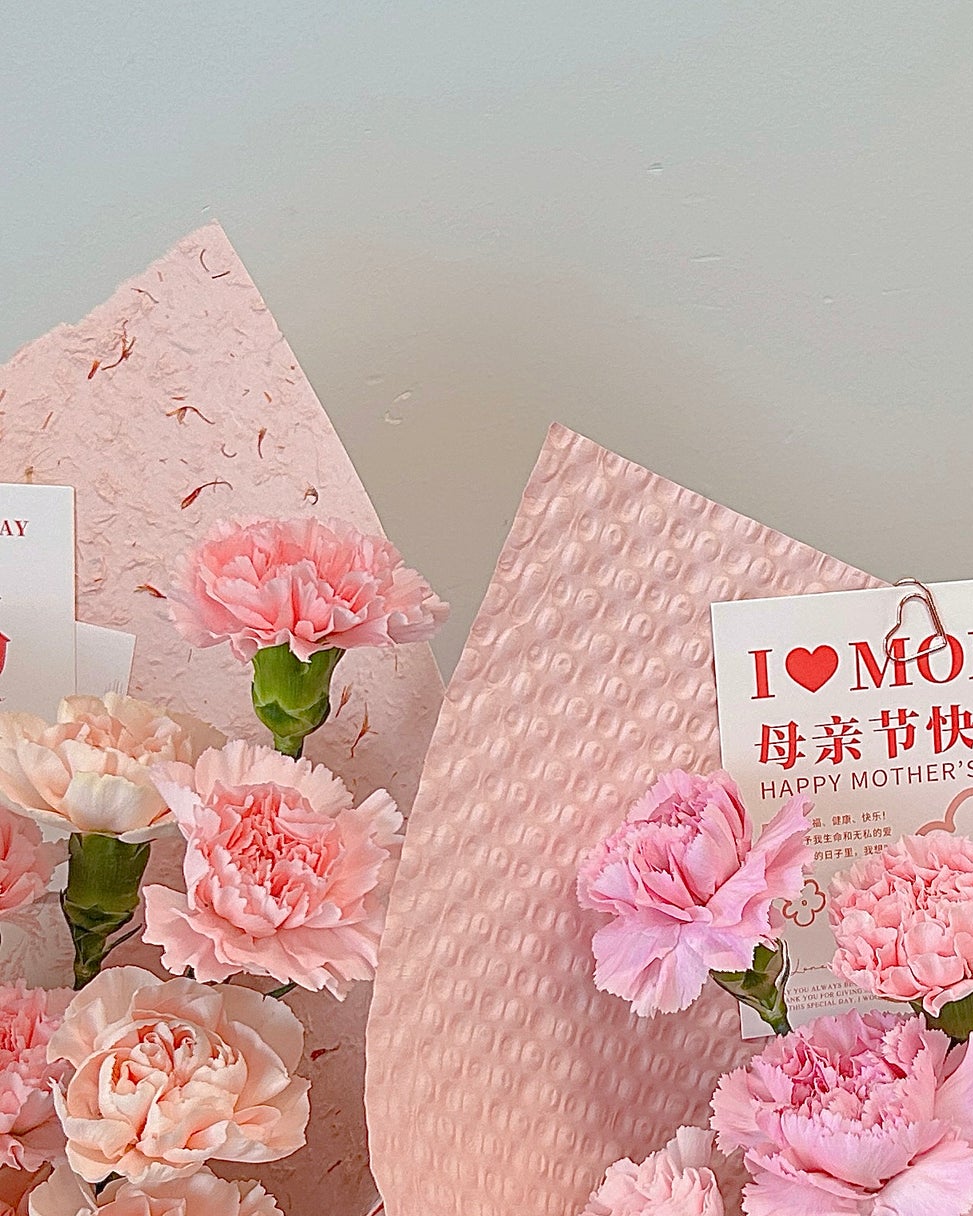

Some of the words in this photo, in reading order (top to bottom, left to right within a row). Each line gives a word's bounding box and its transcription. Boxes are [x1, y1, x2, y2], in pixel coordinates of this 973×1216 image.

[0, 519, 30, 537] AY
[747, 648, 776, 700] I
[760, 773, 842, 800] HAPPY
